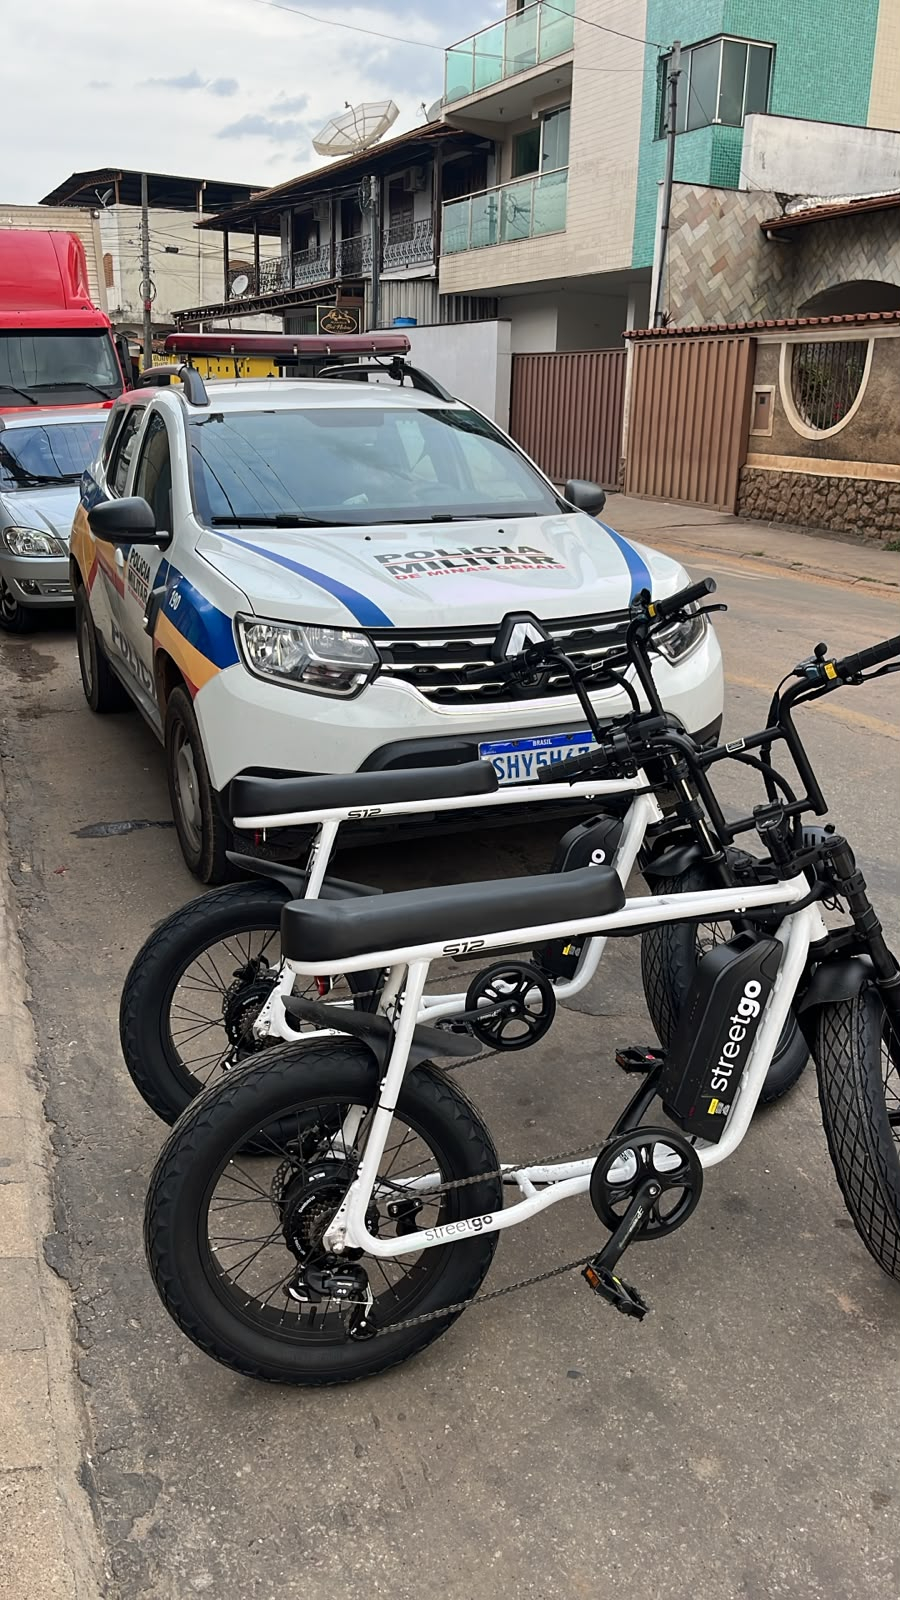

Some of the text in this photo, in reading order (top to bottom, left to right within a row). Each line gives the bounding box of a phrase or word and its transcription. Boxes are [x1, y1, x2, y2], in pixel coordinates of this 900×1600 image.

[385, 556, 561, 575] MILITAR
[427, 565, 491, 577] MINAS
[532, 739, 553, 747] BRASIL
[492, 746, 590, 780] SHY5H
[347, 808, 382, 819] S12
[442, 940, 485, 956] S12
[710, 979, 762, 1092] streetgo
[424, 1215, 493, 1241] streetgo
